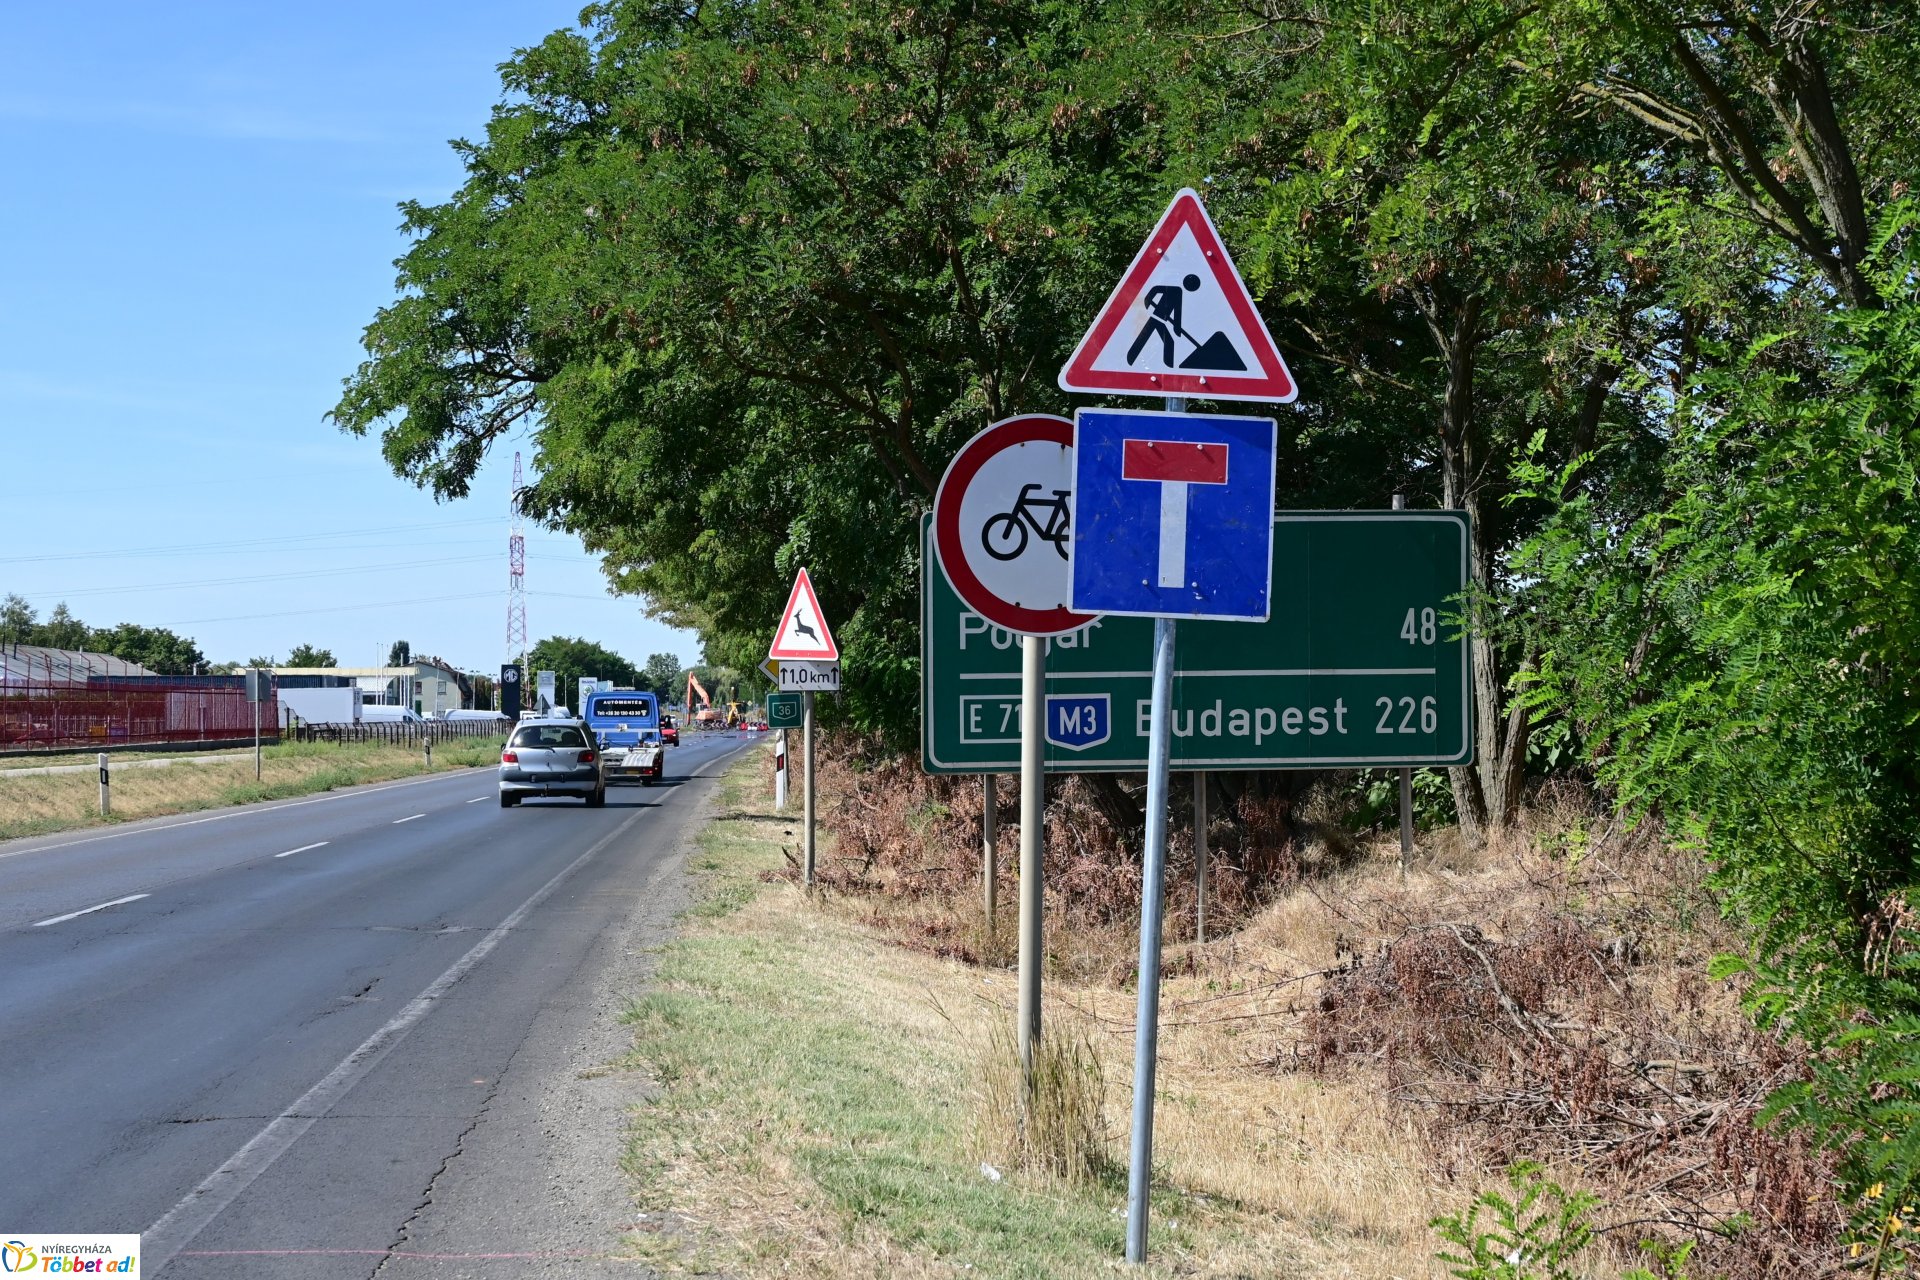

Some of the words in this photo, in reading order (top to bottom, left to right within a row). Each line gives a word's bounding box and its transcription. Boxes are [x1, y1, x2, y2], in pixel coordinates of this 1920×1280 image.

[960, 612, 1103, 658] Por
[1401, 607, 1436, 645] 48
[503, 668, 518, 683] MG
[789, 668, 807, 684] 1.0
[810, 671, 830, 683] km
[778, 705, 791, 715] 36
[970, 704, 982, 733] E
[1059, 705, 1096, 736] M3
[1136, 697, 1348, 745] Budapest
[1375, 696, 1437, 734] 226
